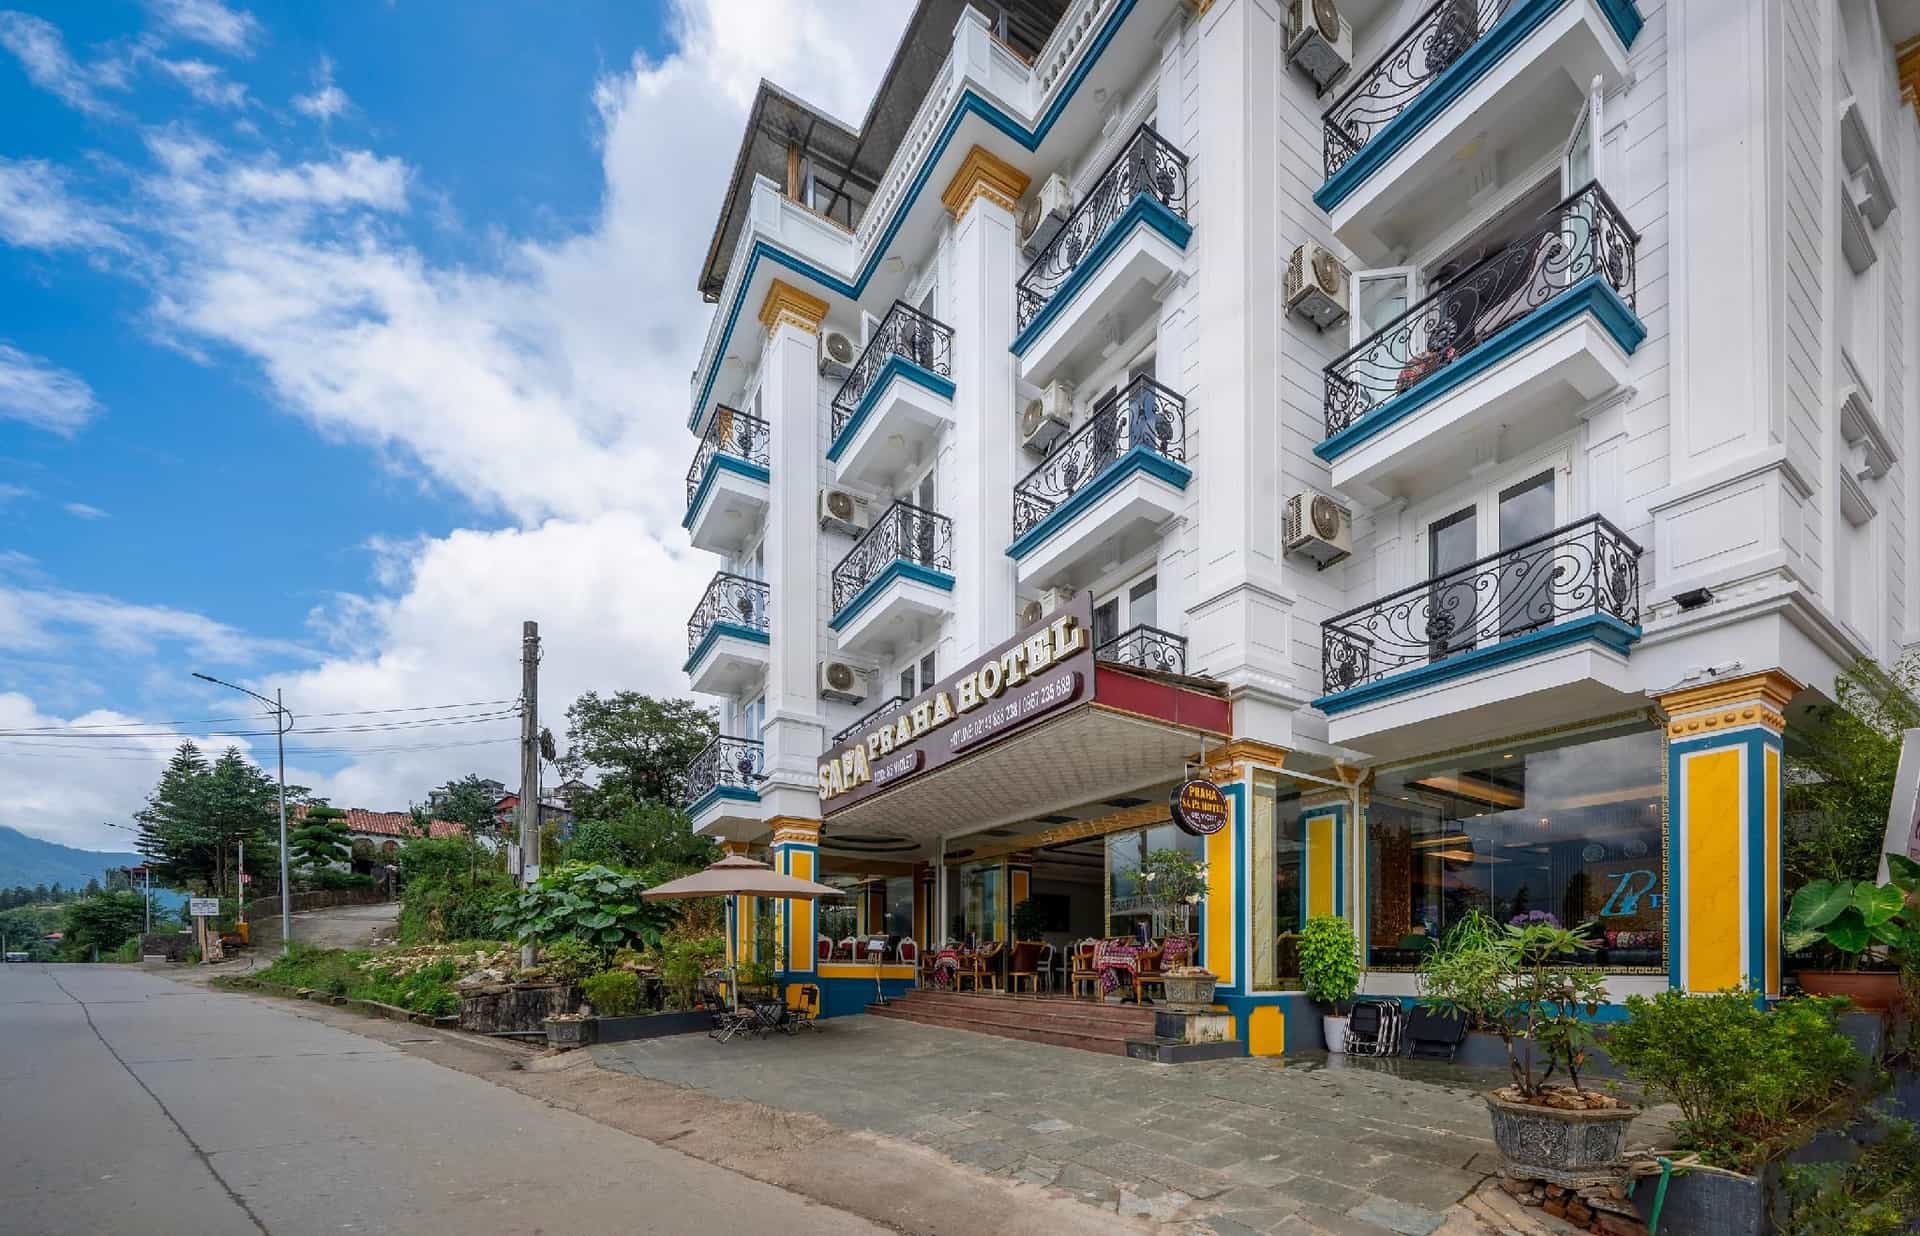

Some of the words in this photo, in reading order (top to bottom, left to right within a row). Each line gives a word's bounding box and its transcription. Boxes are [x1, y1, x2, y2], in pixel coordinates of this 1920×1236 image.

[819, 744, 872, 800] SAPA
[866, 690, 959, 761] PRAHA
[955, 615, 1088, 713] HOTEL
[1189, 786, 1217, 801] PRAHA
